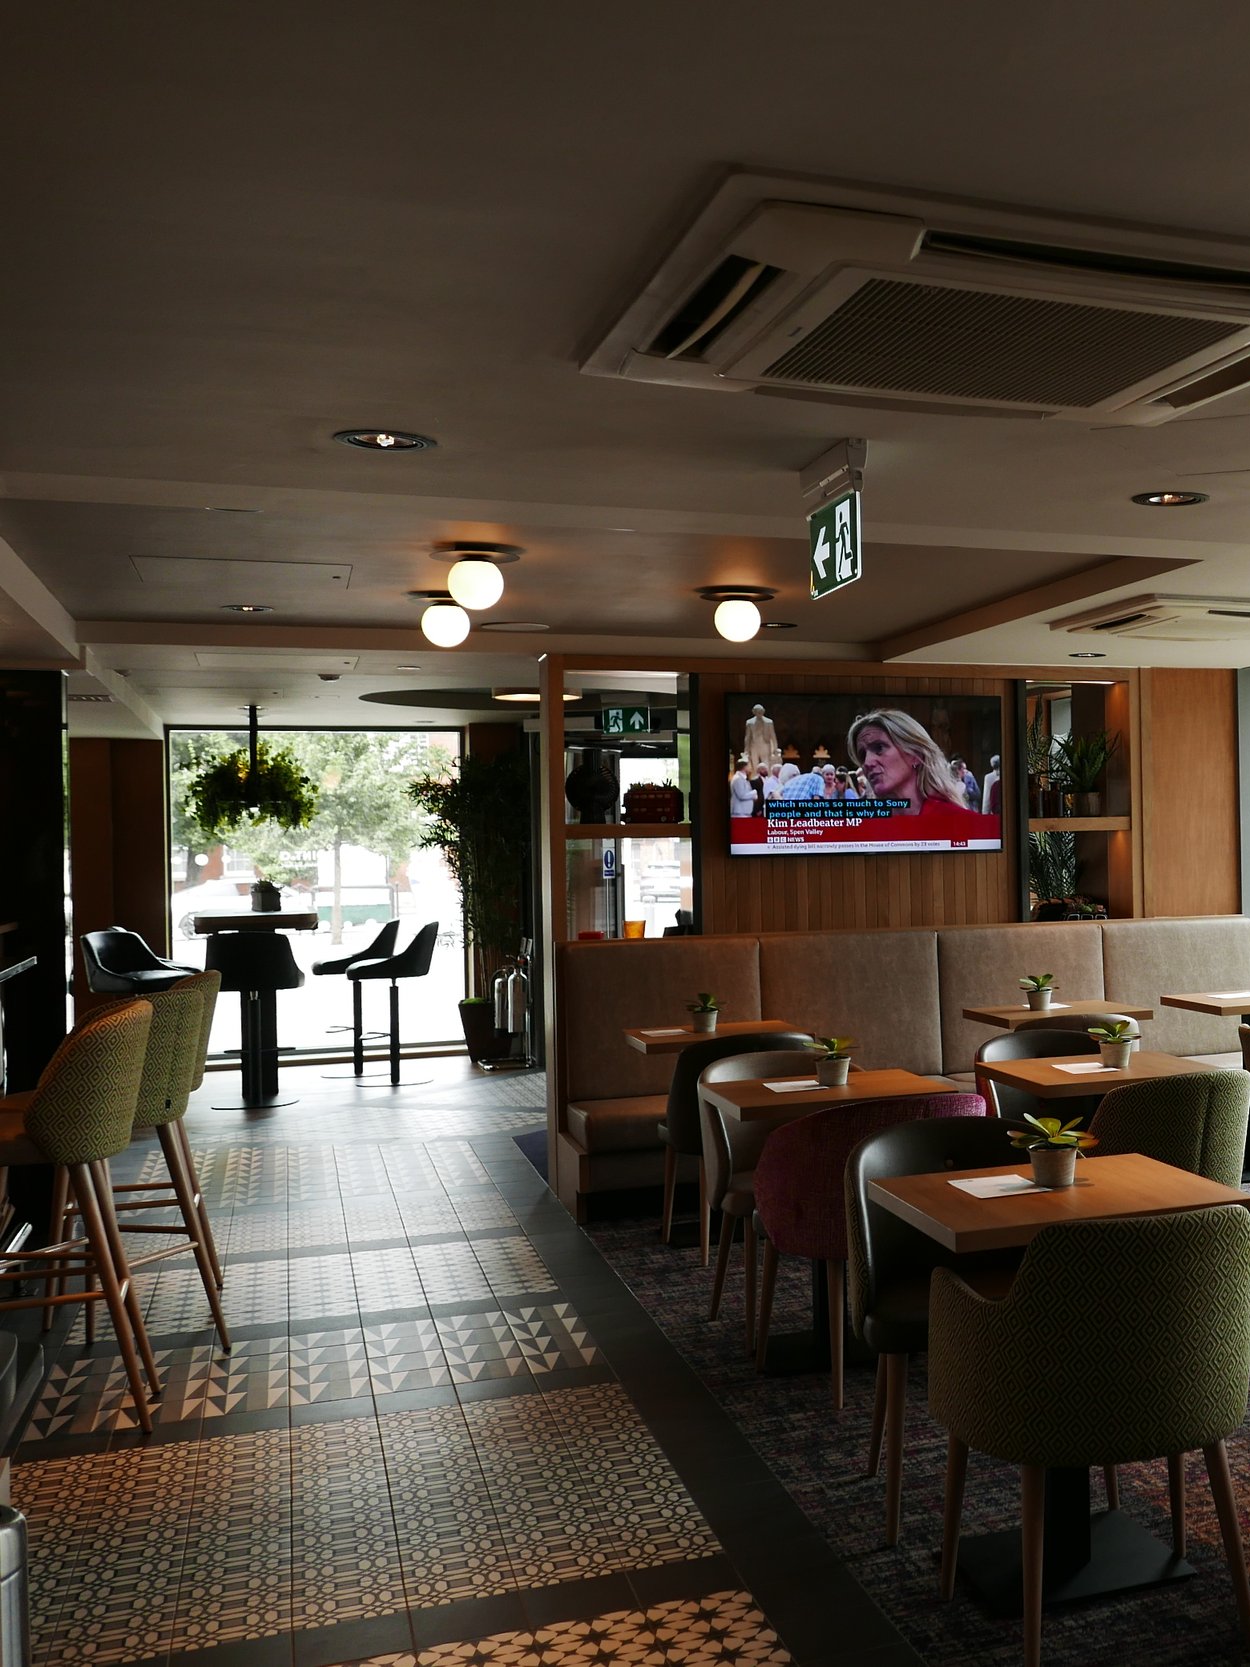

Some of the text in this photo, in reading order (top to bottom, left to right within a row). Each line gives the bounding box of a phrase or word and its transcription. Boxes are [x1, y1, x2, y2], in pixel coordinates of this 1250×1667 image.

[768, 800, 796, 808] which
[846, 799, 872, 808] much
[886, 799, 909, 809] Sony
[769, 808, 890, 819] people and that is why for
[767, 817, 863, 828] Kim Leadbeater MP
[805, 828, 824, 836] Valley
